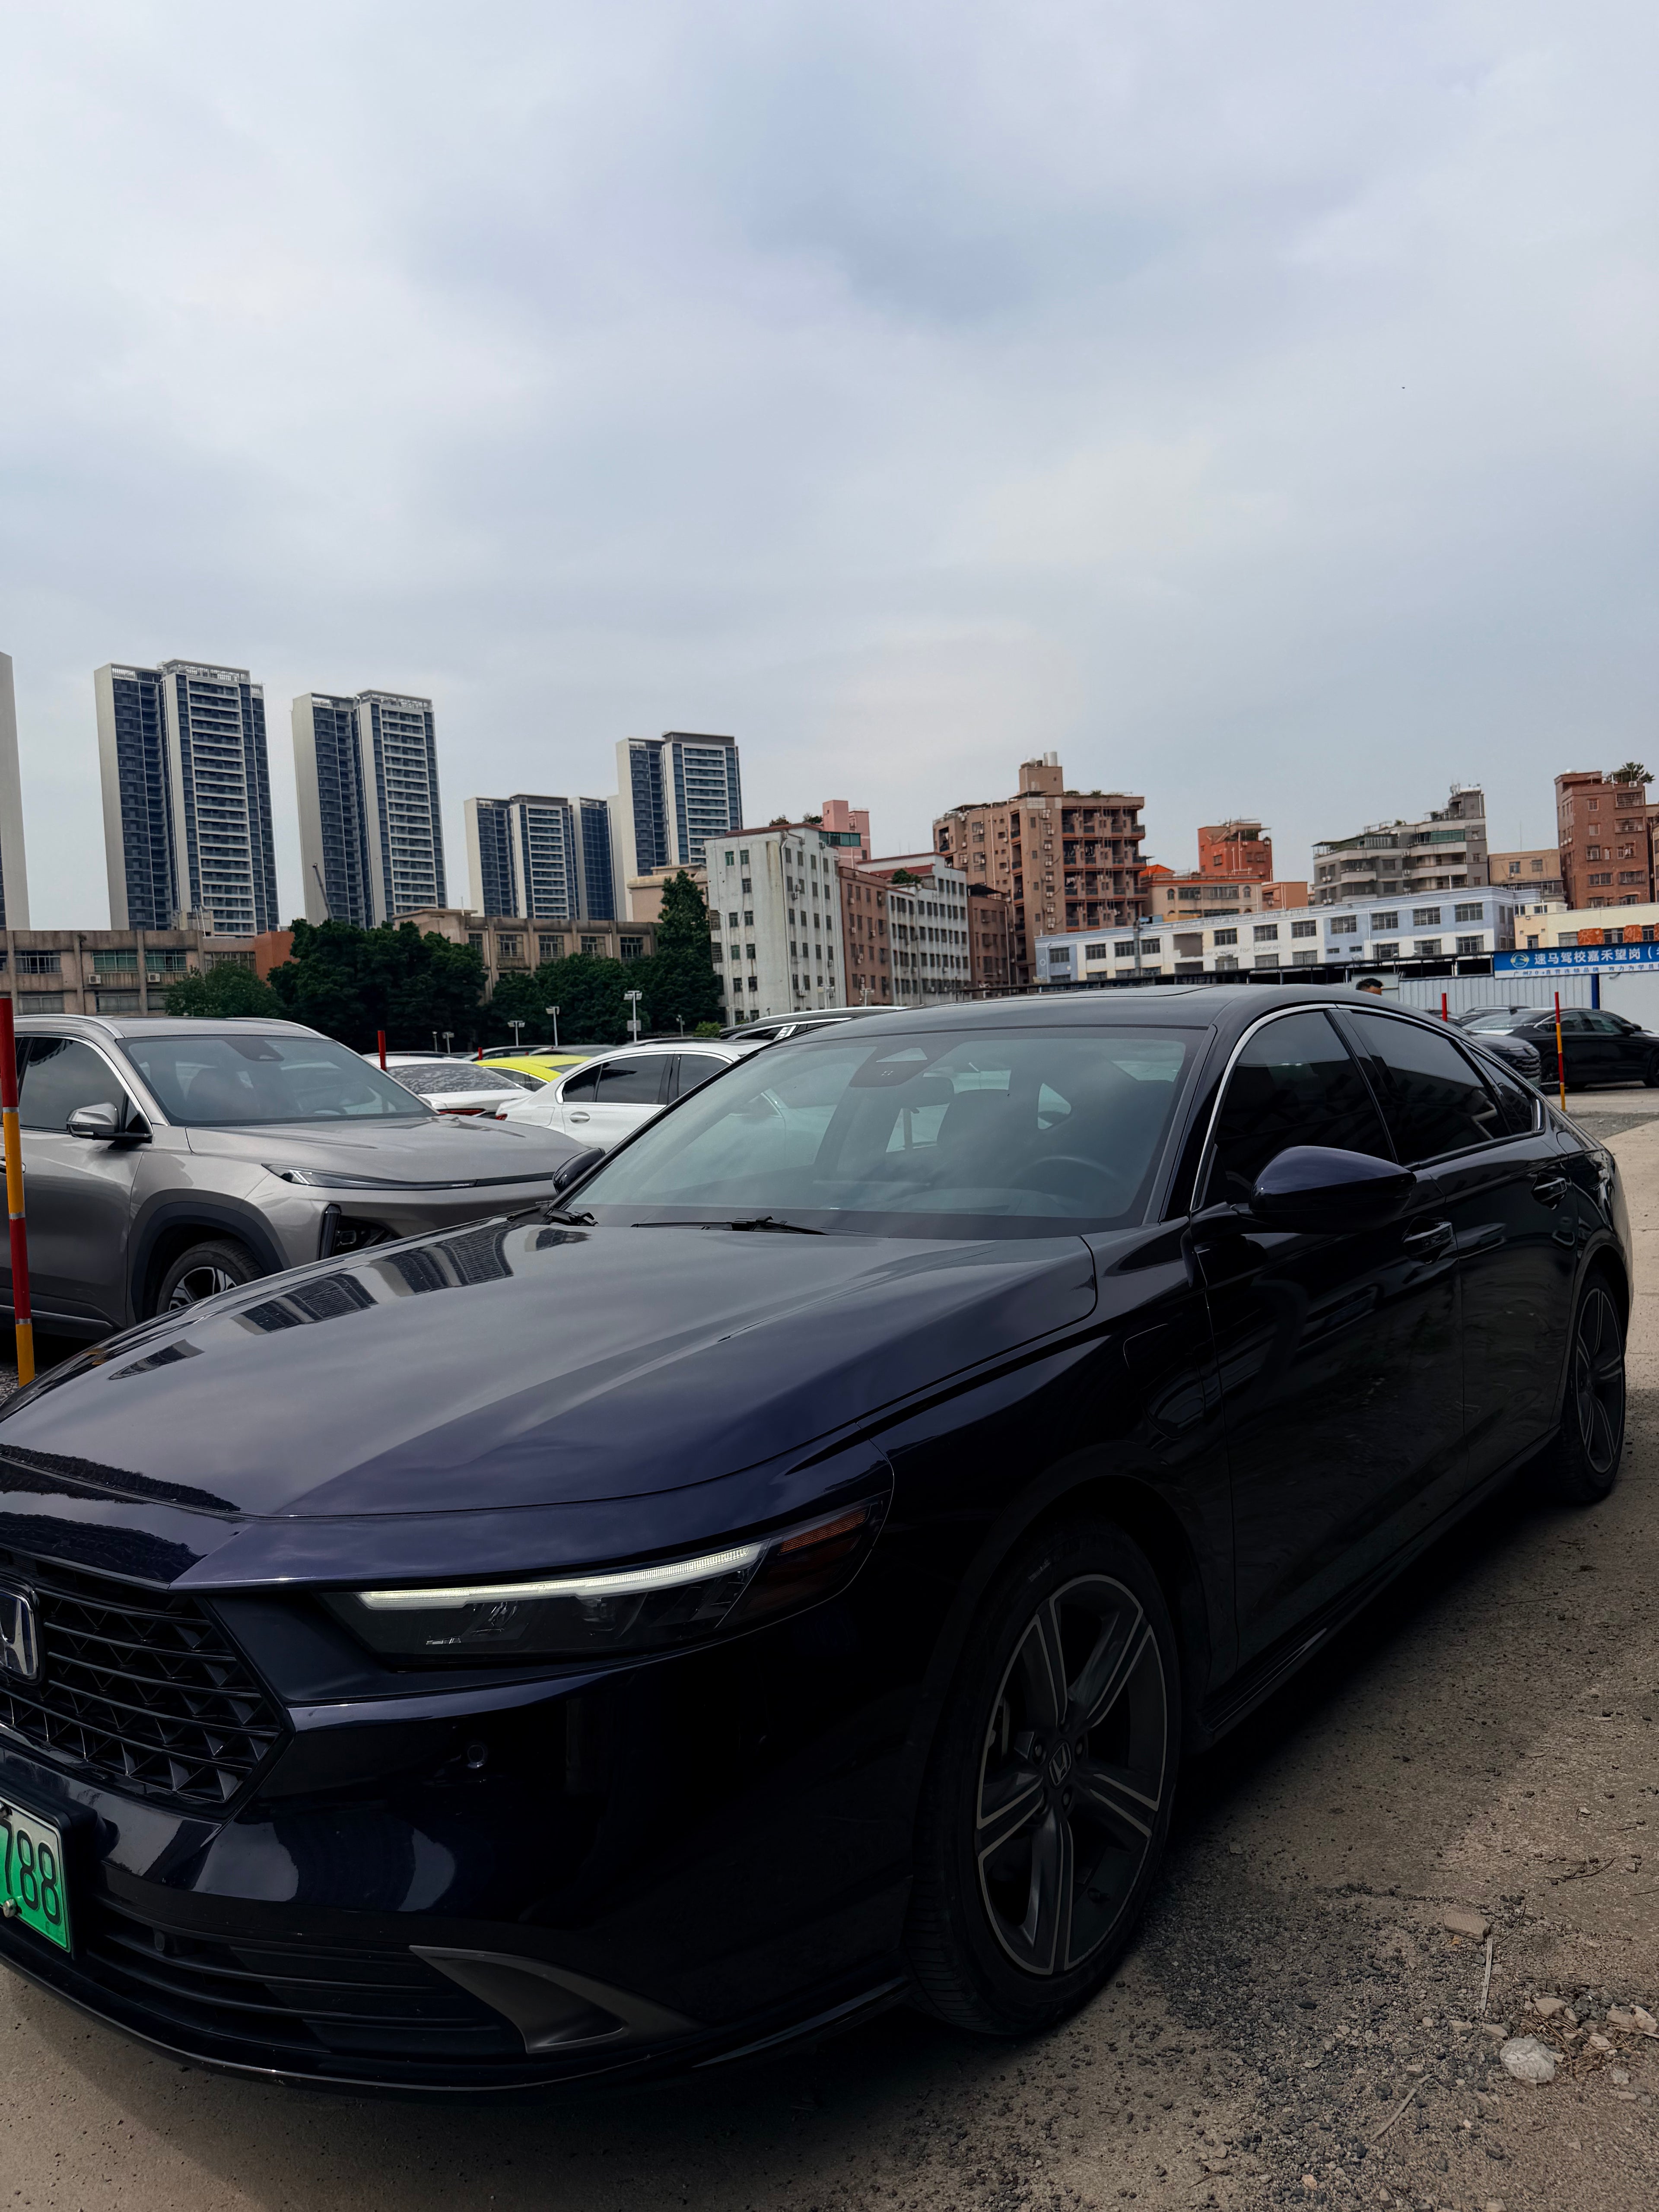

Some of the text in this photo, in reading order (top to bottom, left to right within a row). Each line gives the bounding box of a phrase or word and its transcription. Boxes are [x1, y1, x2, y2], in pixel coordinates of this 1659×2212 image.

[1608, 963, 1659, 972] 致力为学员
